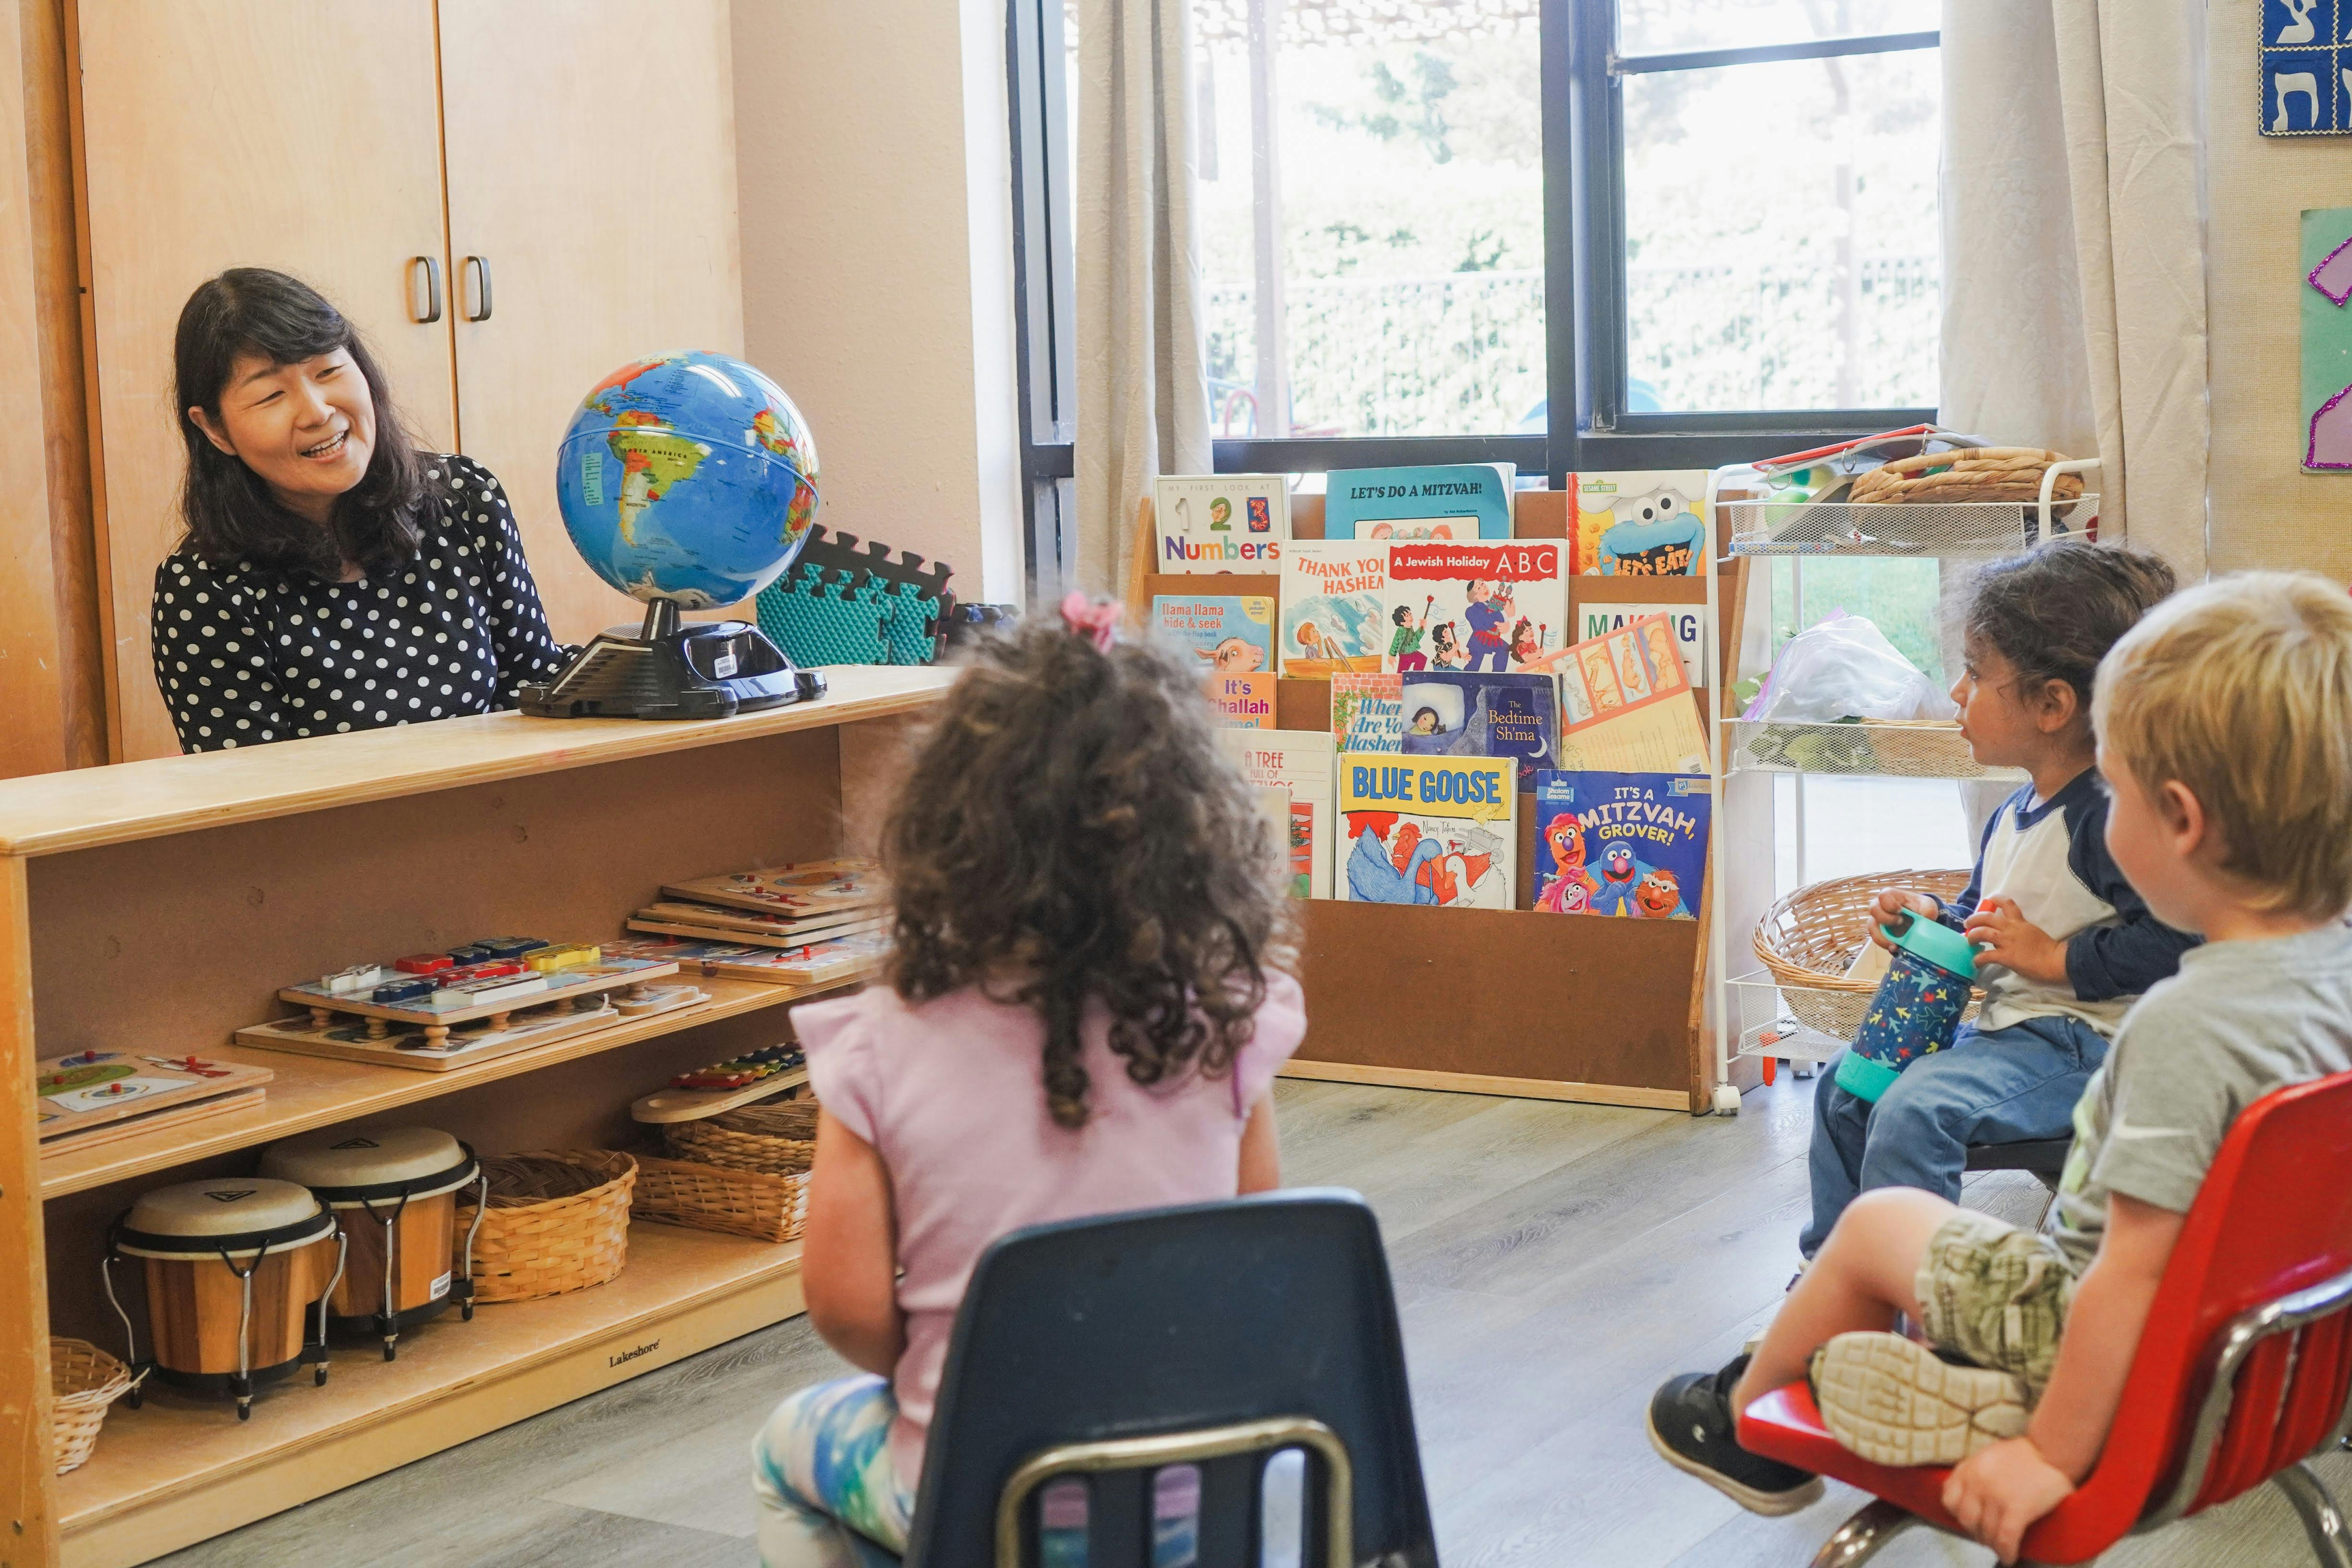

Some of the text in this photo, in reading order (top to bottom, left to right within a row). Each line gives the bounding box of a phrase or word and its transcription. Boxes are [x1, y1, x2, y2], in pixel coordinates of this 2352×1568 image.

[652, 450, 687, 458] AMERICA
[1351, 484, 1481, 499] LET'S DO A MITZVAH!
[1176, 497, 1269, 531] 1 2 3
[1165, 535, 1280, 560] Numbers
[1298, 557, 1352, 577] THANK
[1394, 556, 1403, 566] A
[1406, 556, 1443, 567] Jewish
[1447, 556, 1490, 569] Holiday
[1655, 548, 1693, 575] EAT!
[1162, 603, 1224, 616] llama llama
[1164, 617, 1222, 629] hide & seek
[1588, 615, 1697, 642] MAG
[1225, 680, 1251, 695] It's
[1360, 699, 1402, 715] Wher
[1352, 716, 1402, 734] Are Yo
[1489, 710, 1542, 725] Bedtime
[1497, 727, 1535, 741] Sh'ma
[1245, 751, 1284, 768] A TREE
[1250, 769, 1279, 779] FULL OF
[1353, 766, 1501, 804] BLUE GOOSE
[1614, 787, 1654, 801] IT'S A
[1422, 819, 1456, 838] Nancy Tafuri
[1577, 801, 1696, 840] MITZVAH,
[1598, 823, 1675, 847] GROVER!
[609, 1339, 659, 1368] Lakeshore
